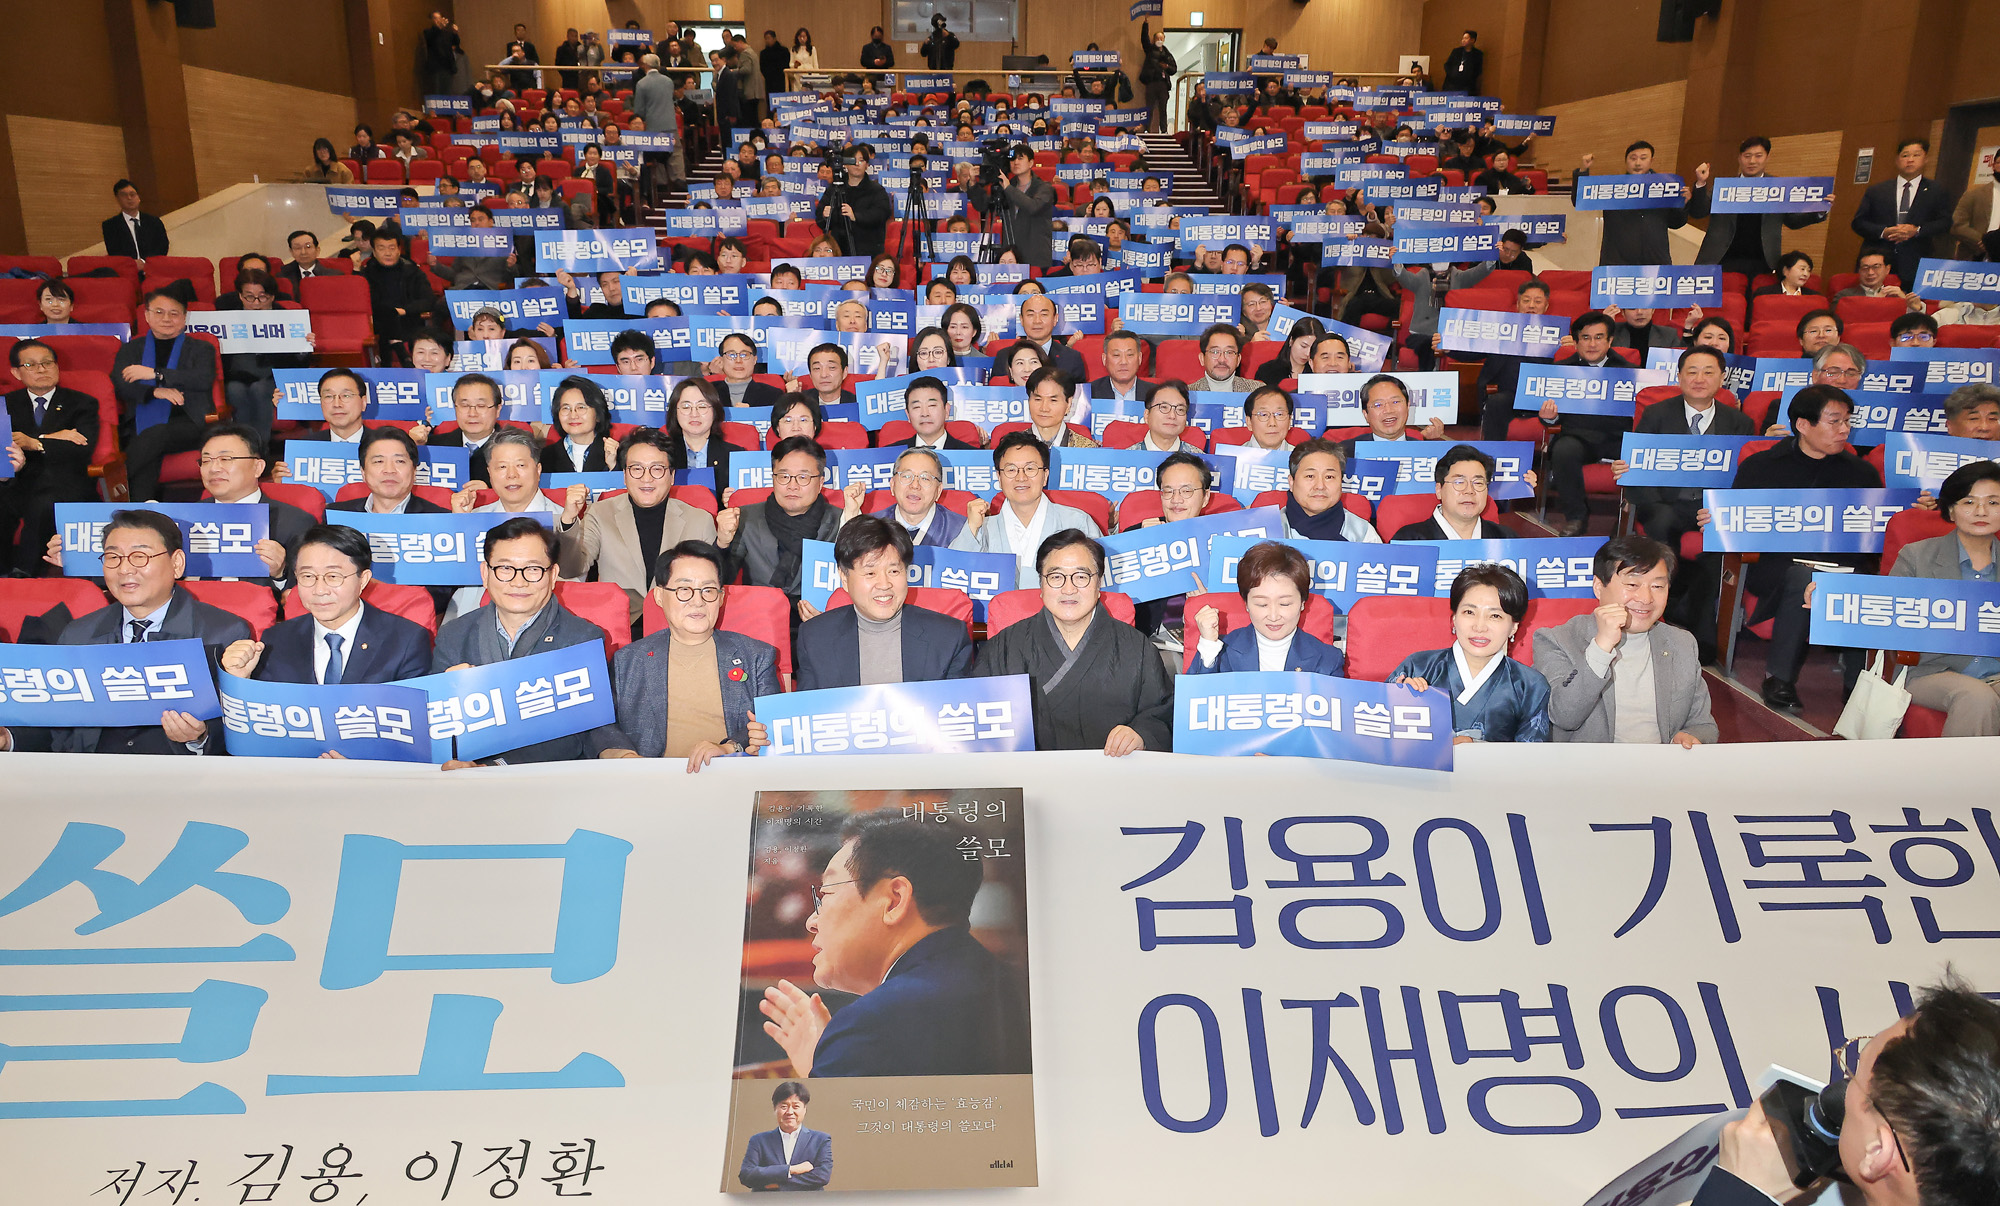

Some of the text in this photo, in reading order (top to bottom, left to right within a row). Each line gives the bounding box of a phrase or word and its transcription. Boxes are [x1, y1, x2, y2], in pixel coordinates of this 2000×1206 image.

[1368, 184, 1438, 198] 대통령의 쓸모
[1582, 182, 1679, 200] 대통령의 쓸모
[1719, 187, 1823, 202] 대통령의 쓸모
[329, 194, 397, 209] 대통령의 쓸모
[746, 201, 811, 215] 대통령의 쓸모
[405, 214, 450, 226] 대통령의
[536, 214, 559, 226] 쓸모
[671, 216, 741, 228] 대통령의 쓸모
[1398, 208, 1474, 222] 대통령의 쓸모
[1186, 226, 1270, 240] 대통령의 쓸모
[1295, 222, 1364, 234] 대통령의 쓸모
[1536, 222, 1559, 234] 쓸모
[432, 234, 508, 248] 대통령의 쓸모
[542, 240, 648, 260] 대통령의 쓸모
[1399, 234, 1492, 252] 대통령의 쓸모
[1324, 244, 1390, 259] 대통령의 쓸모
[837, 266, 864, 280] 쓸모
[703, 286, 739, 304] 쓸모
[1105, 279, 1134, 298] 쓸모
[1598, 276, 1714, 295] 대통령의 쓸모
[522, 298, 559, 316] 쓸모
[1064, 304, 1096, 321] 쓸모
[1126, 304, 1232, 322] 대통령의 쓸모
[876, 311, 908, 329] 쓸모
[231, 323, 249, 338] 꿈
[252, 323, 285, 340] 너머
[289, 323, 306, 338] 꿈
[652, 329, 690, 348] 쓸모
[1445, 319, 1560, 344] 대통령의 쓸모
[1345, 338, 1380, 359] 쓸모
[1926, 361, 1992, 383] 통령의
[376, 383, 420, 404] 쓸모
[1525, 377, 1608, 400] 대통령의
[1864, 374, 1913, 394] 쓸모
[1323, 388, 1451, 409] 용의 꿈
[1630, 448, 1732, 472] 대통령의
[847, 464, 895, 490] 쓸모
[1060, 465, 1159, 491] 대통령의
[1716, 506, 1833, 532] 대통령의
[188, 522, 253, 554] 쓸모
[361, 532, 469, 564] 통령의
[1356, 562, 1419, 595] 쓸모
[1536, 556, 1594, 588] 쓸모
[1826, 594, 1966, 631] 대통령의
[0, 663, 195, 703] 령의 쓸모
[427, 666, 594, 741] 령의 쓸모
[220, 689, 413, 745] 통령의 쓸모
[1189, 693, 1432, 740] 대통령의 쓸모
[771, 700, 1015, 755] 대통령의 쓸모
[901, 800, 1006, 823] 대통령의
[766, 818, 822, 826] 이재명의 시간
[956, 836, 1011, 861] 쓸모
[1119, 807, 2000, 951] 김용이 기록한
[0, 820, 633, 1118] 쓸모
[1137, 981, 1753, 1137] 이재명의
[852, 1098, 890, 1112] 국민이
[895, 1098, 947, 1111] 체감하는
[856, 1119, 996, 1133] 그것이 대통령의 쓸모다
[90, 1138, 605, 1206] 저자. 김용, 이정환
